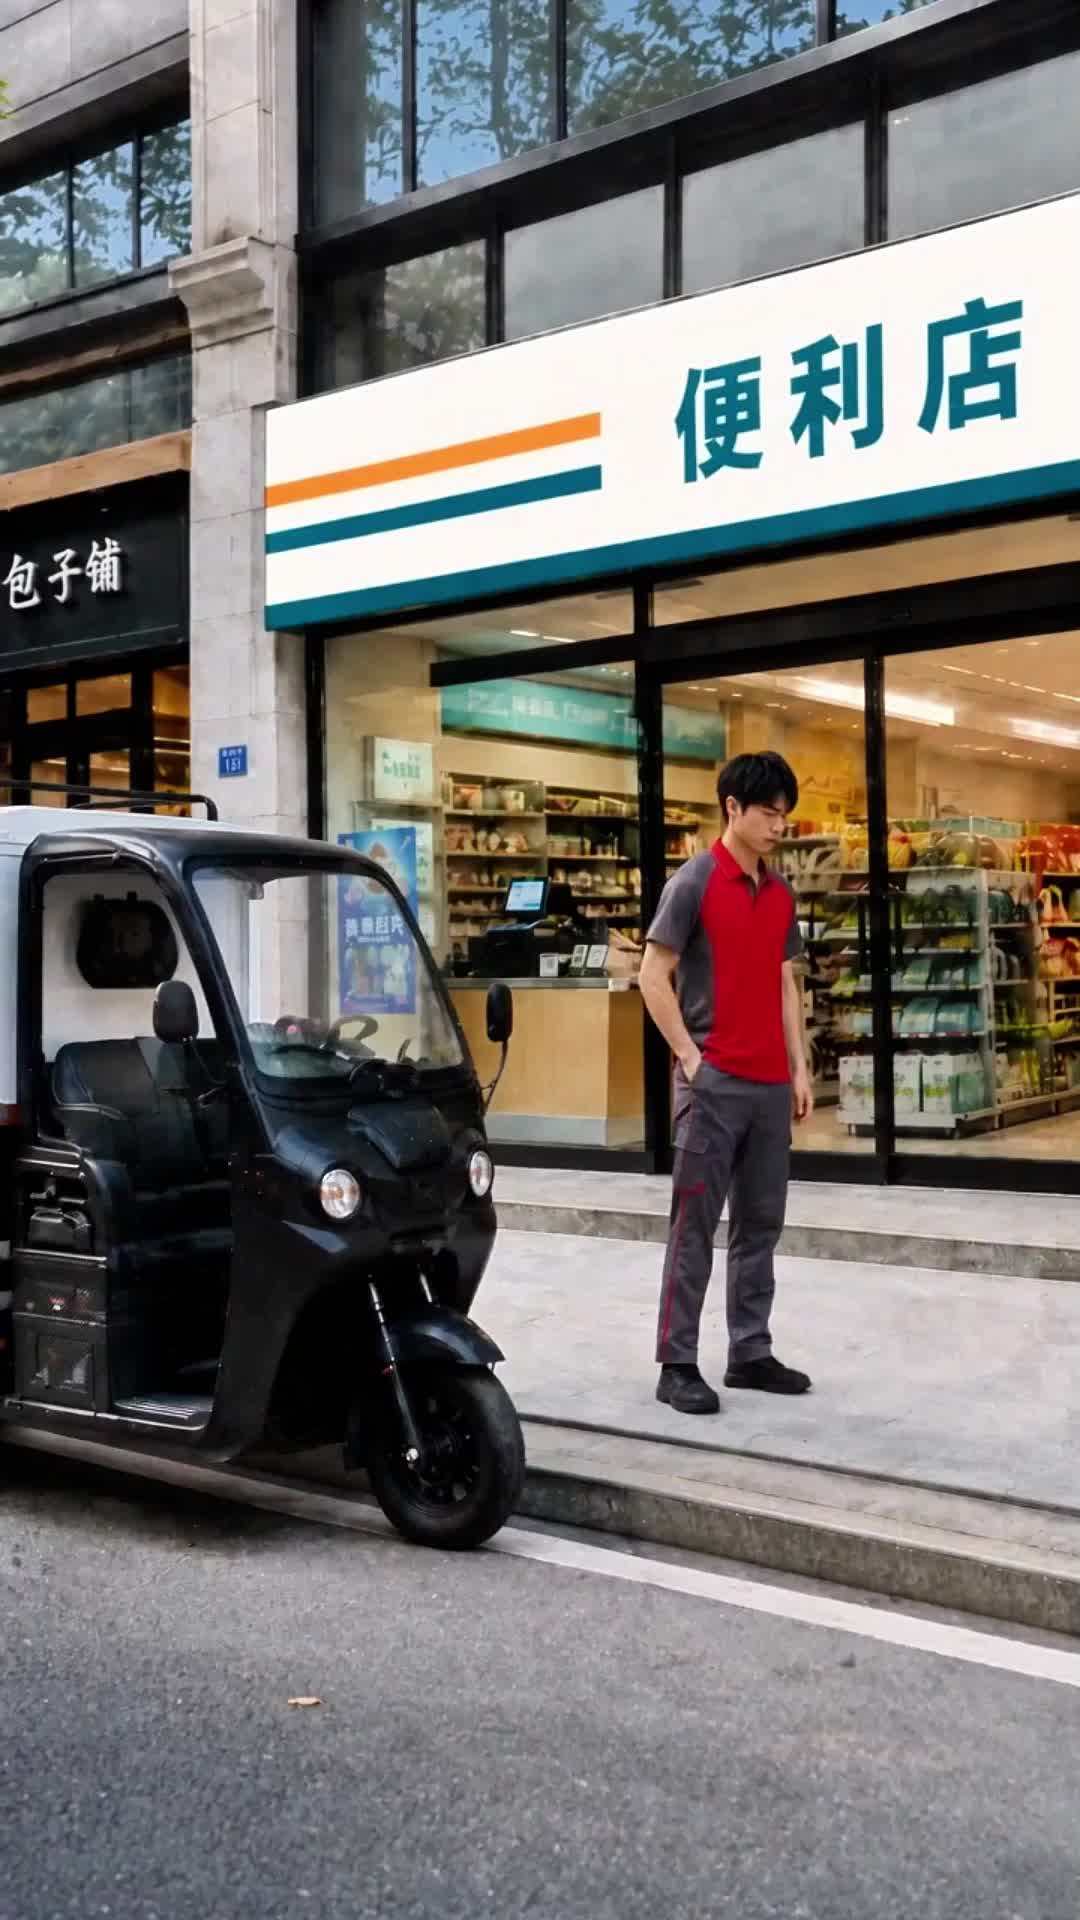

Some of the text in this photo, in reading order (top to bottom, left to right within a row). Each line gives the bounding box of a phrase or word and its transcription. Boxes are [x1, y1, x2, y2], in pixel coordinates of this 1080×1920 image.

[675, 297, 1023, 484] 便利店
[2, 537, 121, 609] 包子铺
